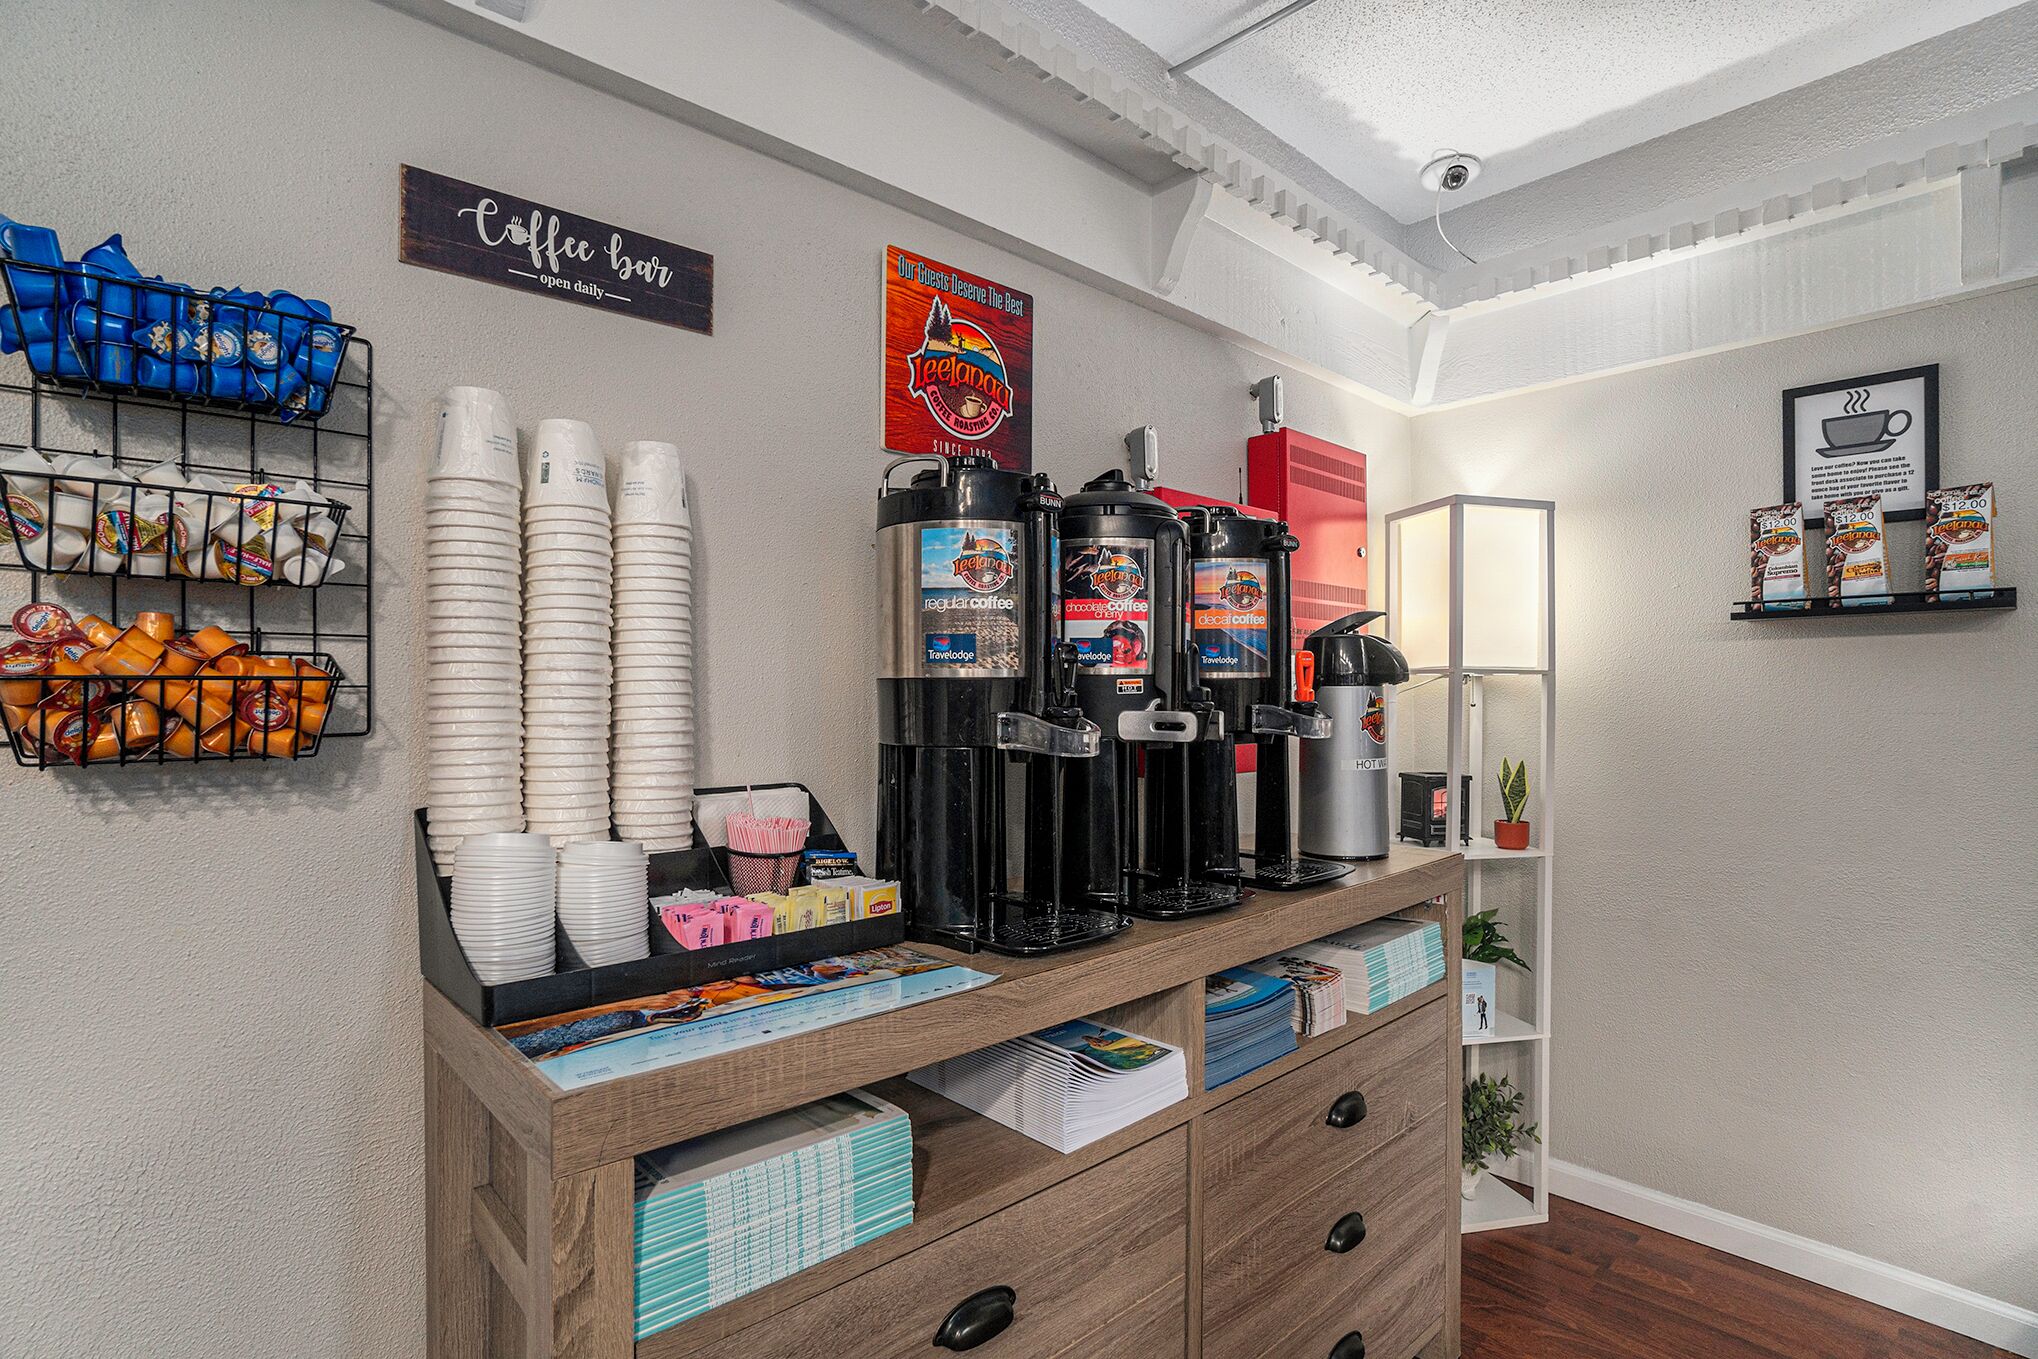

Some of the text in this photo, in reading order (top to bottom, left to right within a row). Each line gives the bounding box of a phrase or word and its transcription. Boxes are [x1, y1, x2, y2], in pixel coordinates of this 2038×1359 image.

[604, 233, 673, 288] bar
[540, 273, 604, 300] open daily
[898, 254, 1024, 317] Our Guests Deserve The Best
[914, 354, 1010, 411] Leelanau
[929, 390, 1000, 432] COFFEE ROASTING CO.
[933, 439, 962, 457] SINCE
[1040, 496, 1062, 508] BUNN
[1942, 499, 1987, 511] $12.00
[1762, 518, 1796, 529] $12.00
[1836, 512, 1874, 524] $12.00
[1934, 520, 1988, 534] Leelanau
[1283, 538, 1298, 548] BUNN
[954, 556, 1013, 576] Leelanau
[1093, 569, 1144, 588] Leelanau
[1221, 584, 1263, 600] Leelanau
[925, 595, 1014, 612] regular coffee
[1066, 602, 1108, 612] chocolate
[1107, 600, 1148, 612] coffee
[32, 611, 50, 632] delight
[1094, 610, 1124, 620] cherry
[1198, 614, 1265, 624] decaf coffee
[928, 650, 975, 662] Travelodge
[1078, 652, 1112, 662] avelodge
[1202, 656, 1238, 666] Travelodge
[1356, 760, 1376, 769] HOT
[811, 866, 830, 876] English
[872, 902, 891, 912] Lipton
[708, 954, 756, 968] Mind Reader
[674, 1027, 695, 1036] your
[698, 1022, 728, 1031] points
